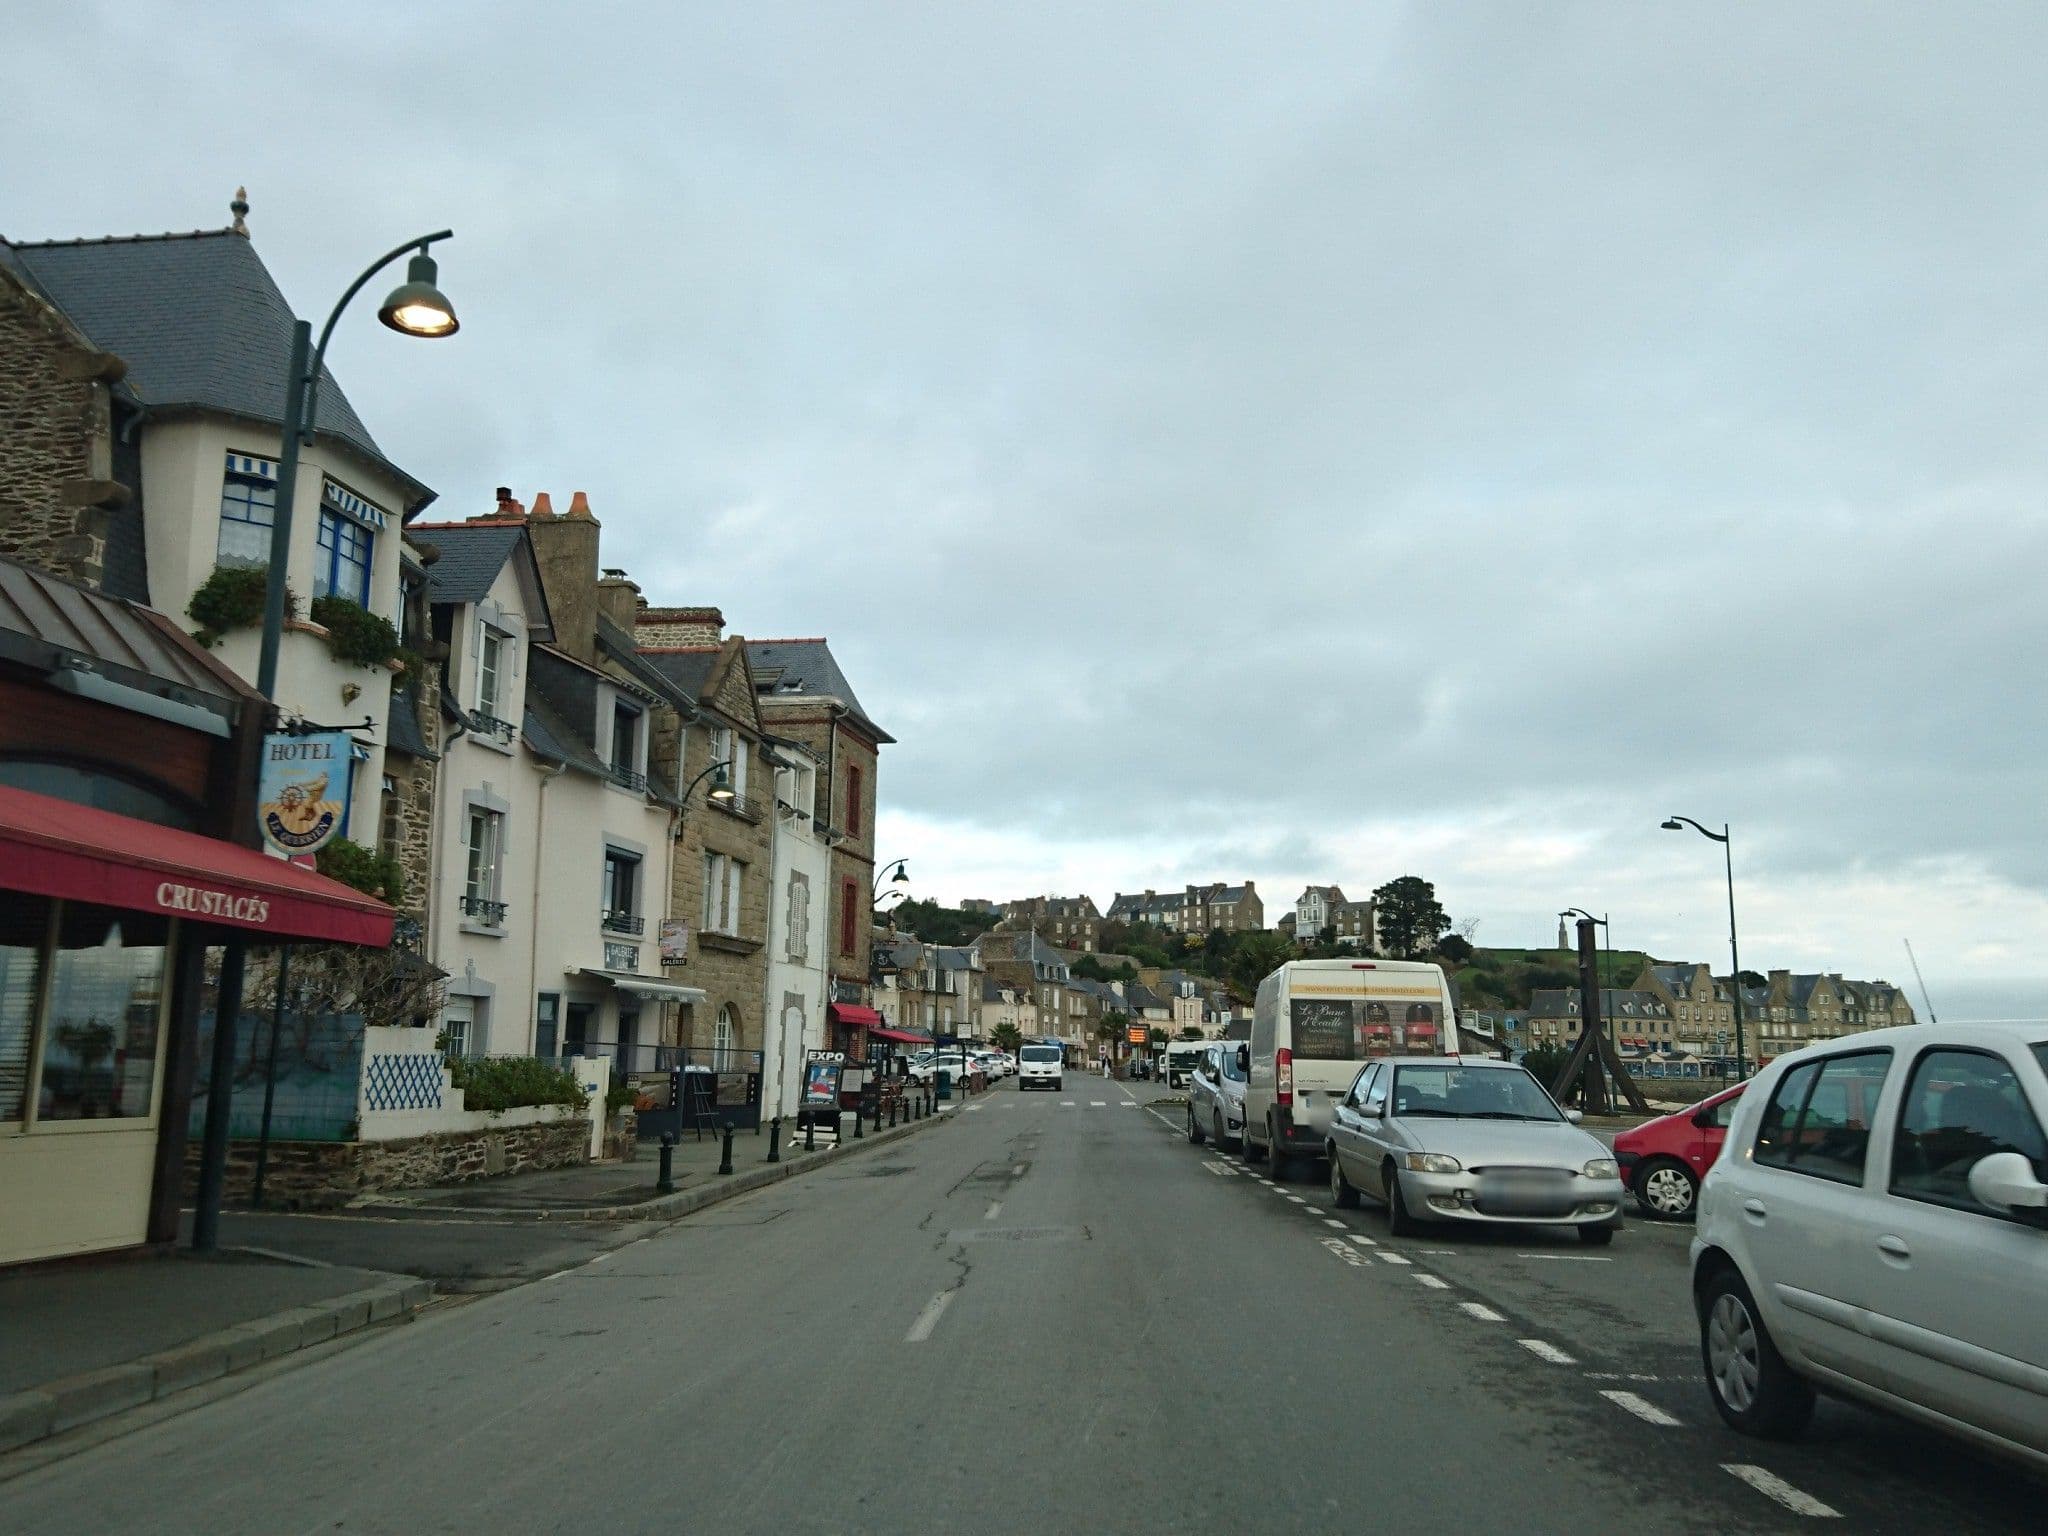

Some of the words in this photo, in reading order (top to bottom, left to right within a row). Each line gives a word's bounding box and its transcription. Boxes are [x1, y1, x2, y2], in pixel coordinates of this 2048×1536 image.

[271, 743, 336, 761] HOTEL
[157, 882, 269, 923] CRUSTACÉS
[807, 1051, 845, 1062] EXPO
